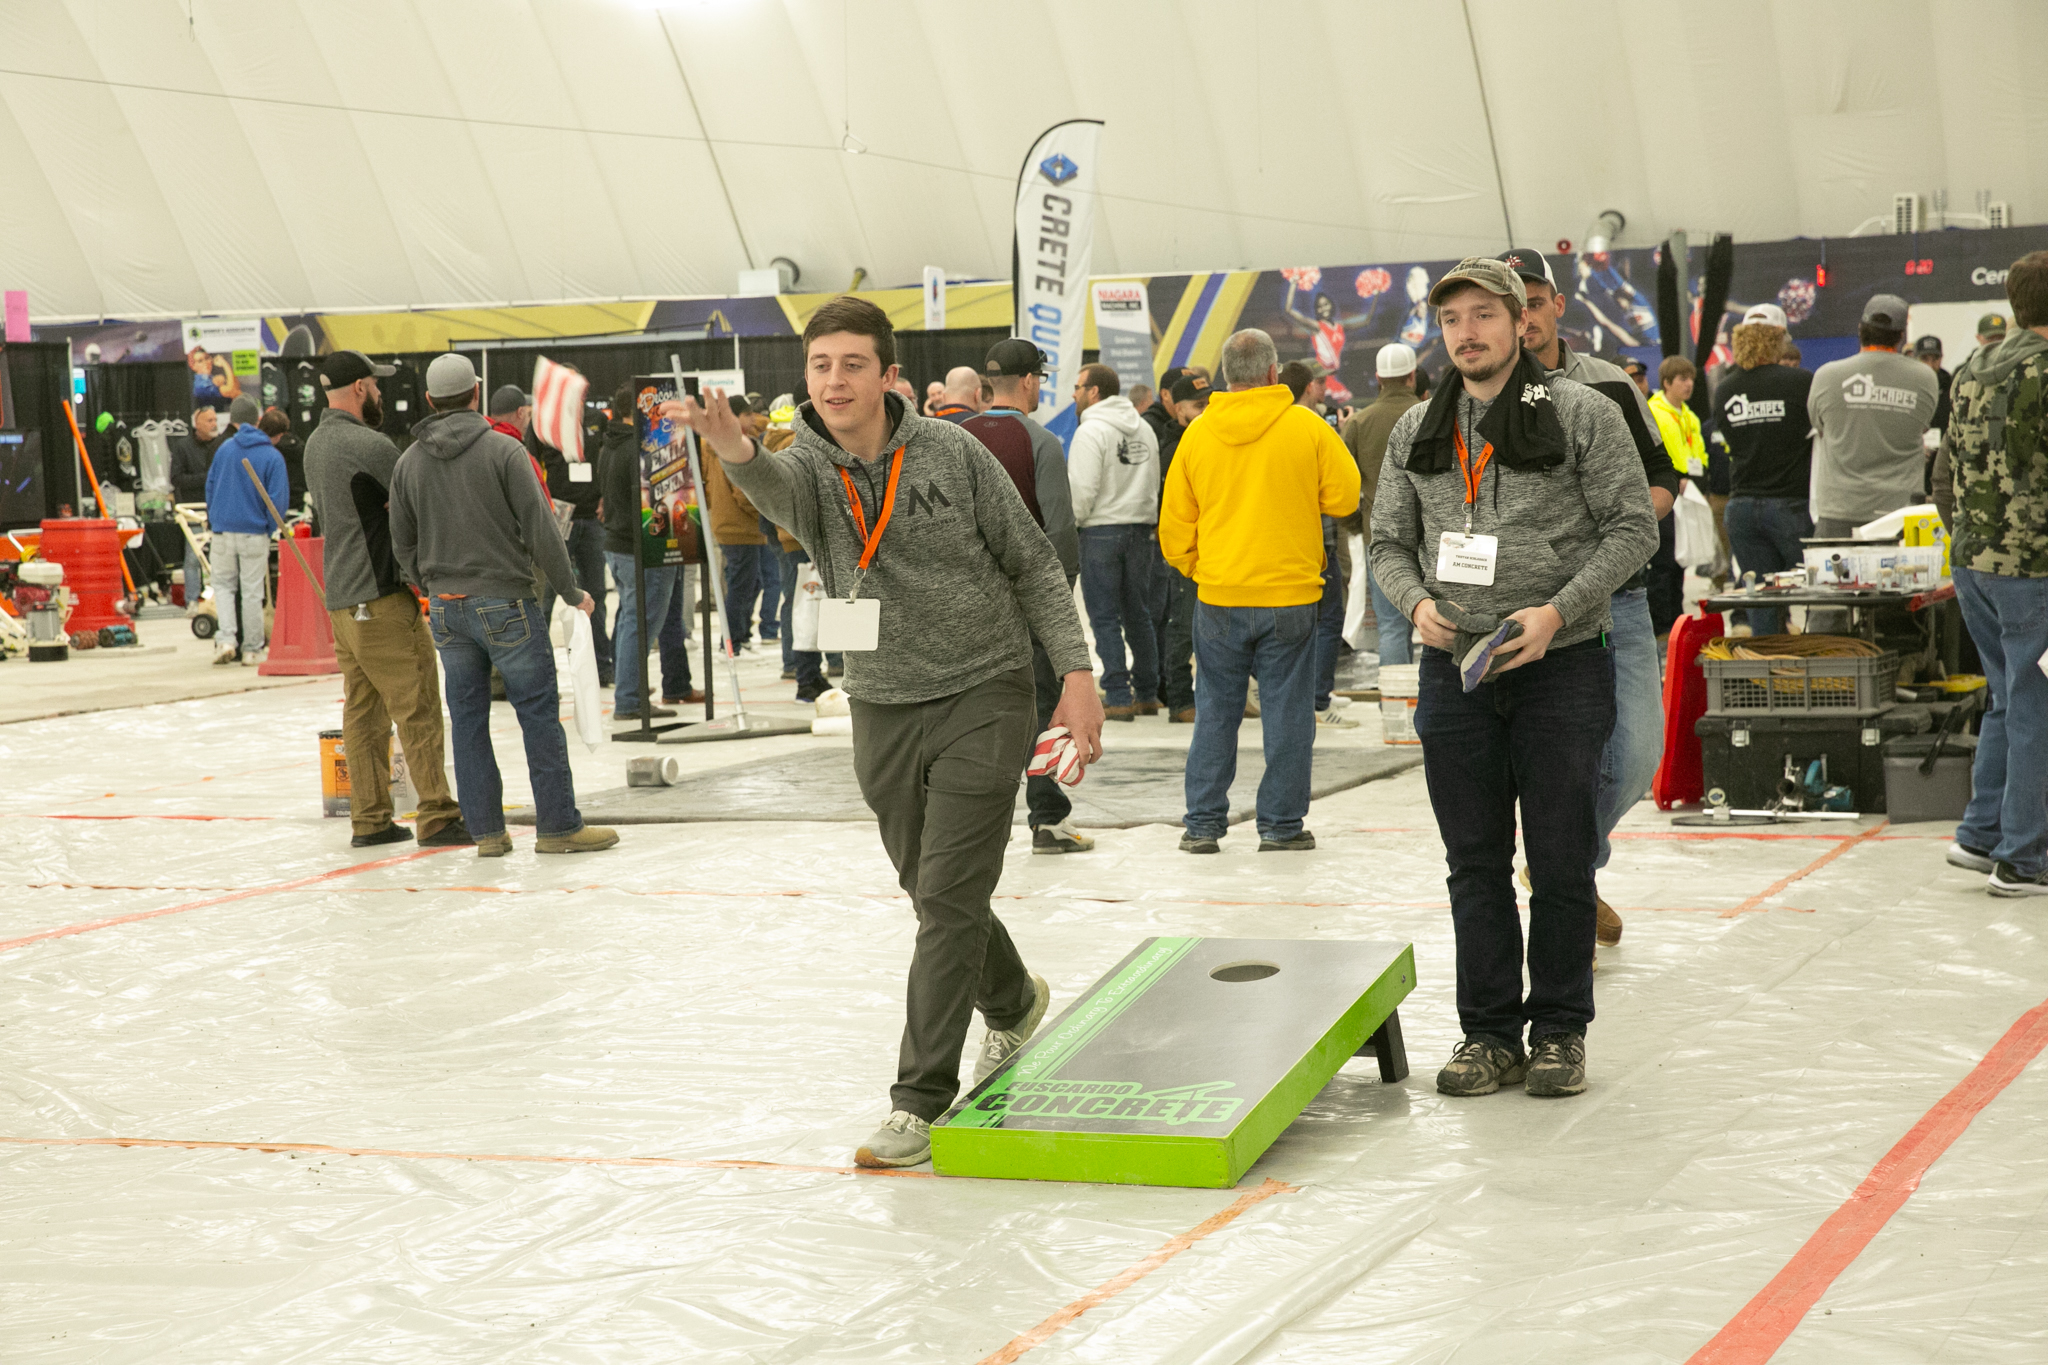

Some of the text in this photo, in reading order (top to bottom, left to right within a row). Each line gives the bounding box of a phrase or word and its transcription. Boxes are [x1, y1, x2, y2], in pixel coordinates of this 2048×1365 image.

[1034, 192, 1073, 297] CRETE
[1097, 289, 1142, 302] NIAGARA
[1461, 562, 1488, 571] CONCRETE
[1017, 945, 1174, 1077] We Pour Ordinary To Extraordinary
[1006, 1081, 1137, 1096] FUSCARDO
[974, 1093, 1242, 1121] CONCRETE
